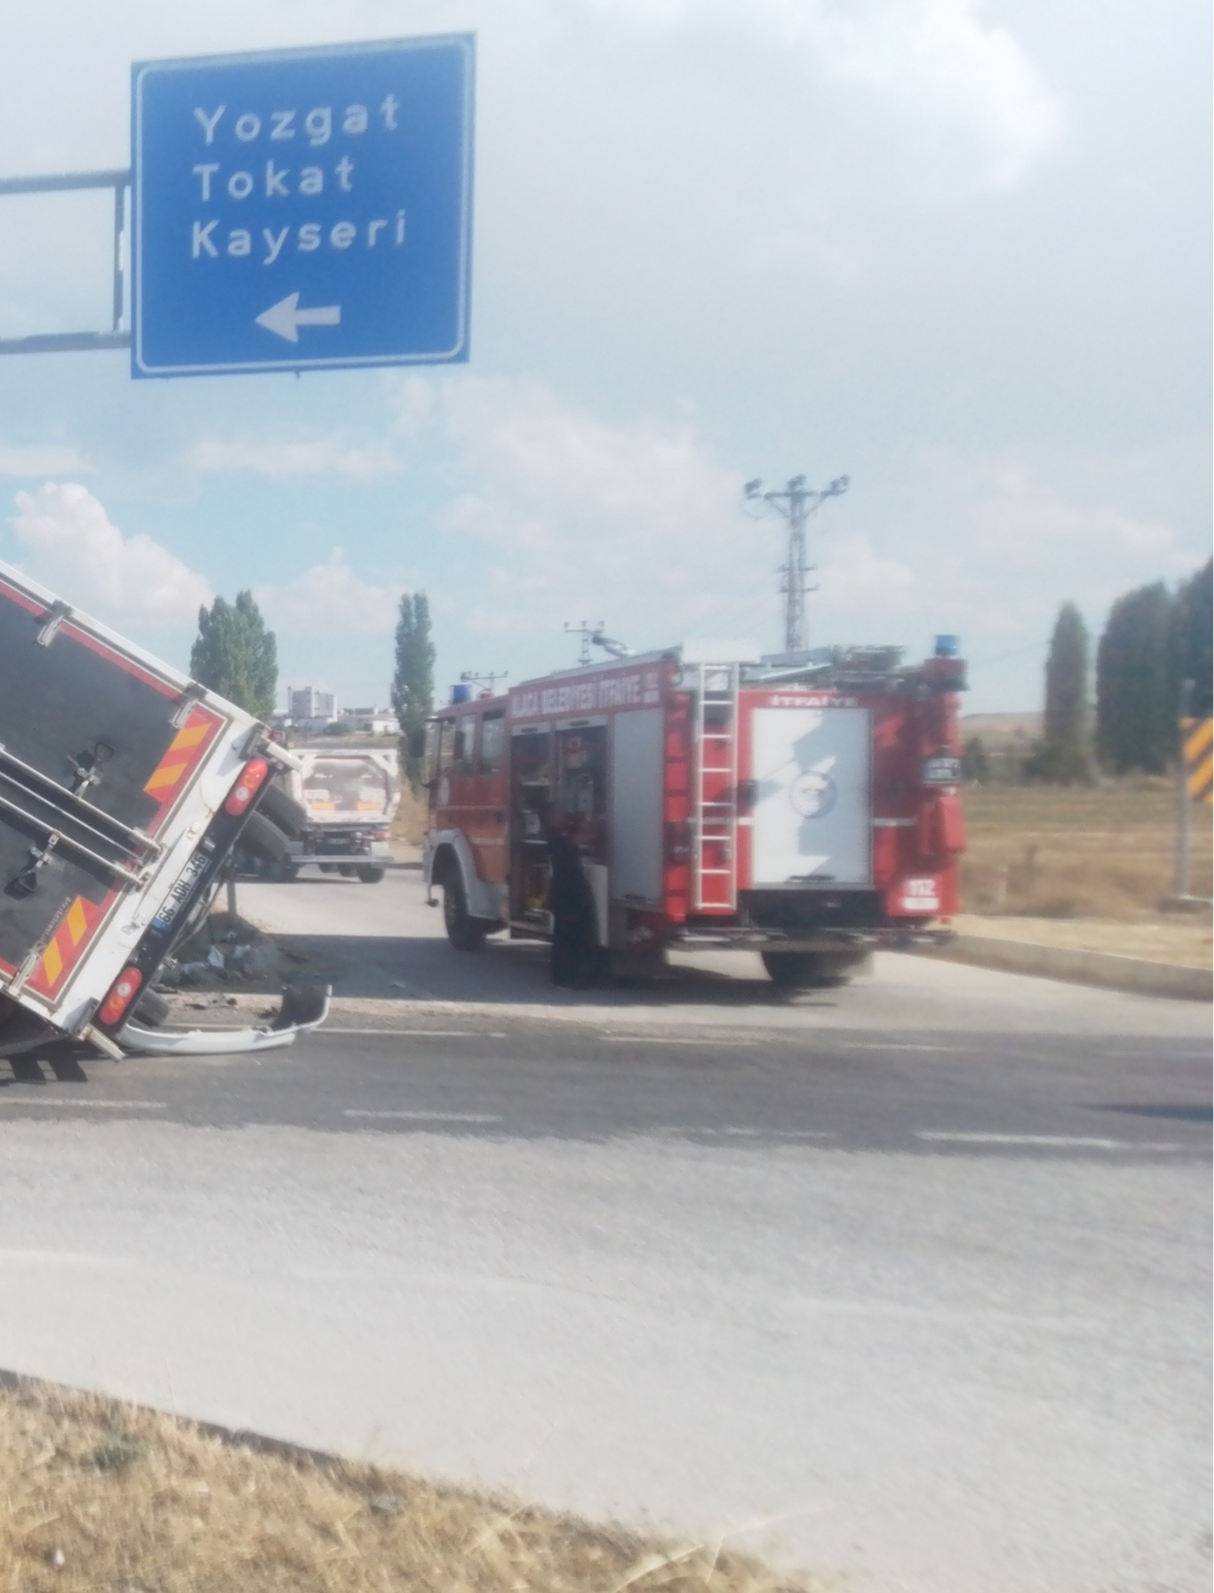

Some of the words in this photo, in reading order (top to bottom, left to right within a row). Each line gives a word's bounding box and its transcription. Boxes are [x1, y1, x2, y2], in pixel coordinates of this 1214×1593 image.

[193, 93, 400, 146] Yozgat
[193, 155, 355, 202] Tokat
[192, 209, 407, 266] Kayseri
[159, 906, 175, 923] 66
[170, 879, 191, 904] ADH
[186, 853, 206, 877] 346
